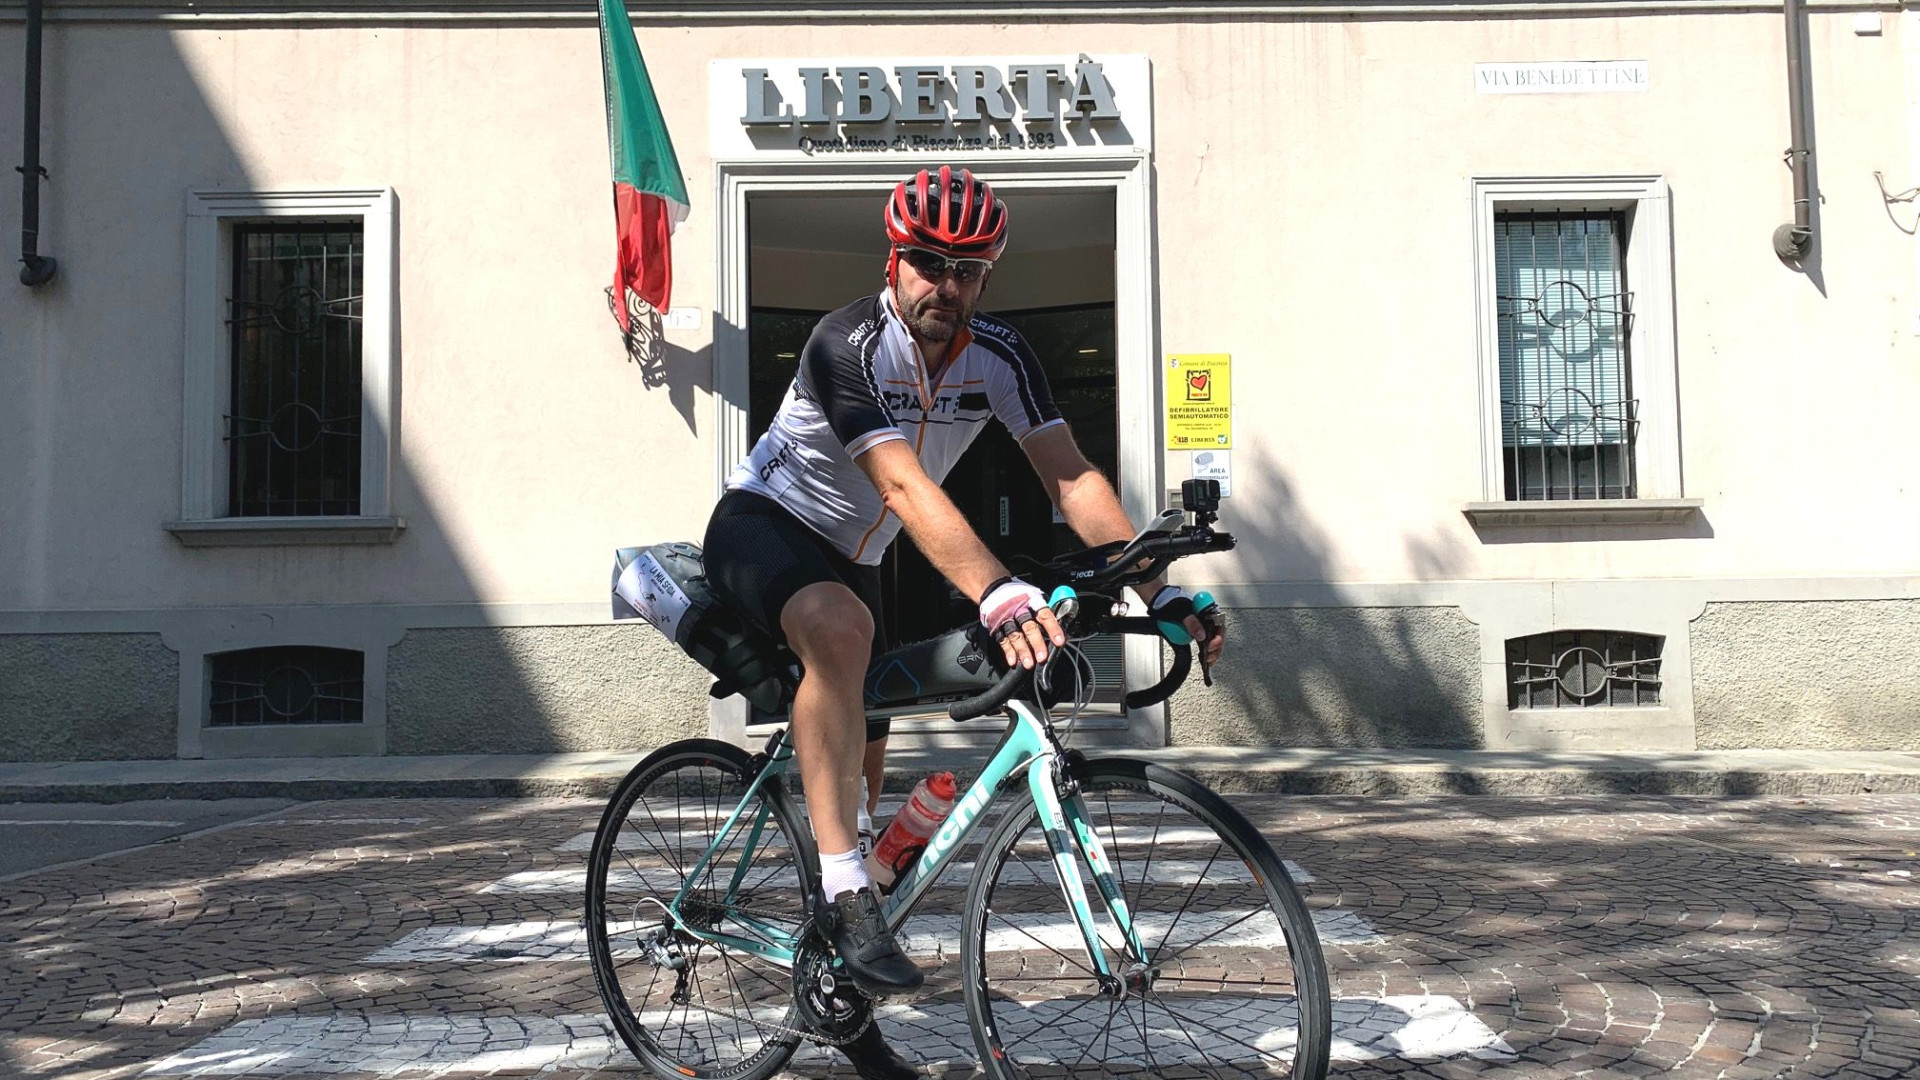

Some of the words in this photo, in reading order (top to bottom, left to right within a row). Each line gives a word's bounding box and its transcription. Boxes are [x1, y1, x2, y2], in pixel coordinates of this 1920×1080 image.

[1482, 69, 1509, 86] VIA
[1515, 68, 1645, 86] BENEDETTINE
[740, 53, 1121, 125] LIBERTÀ
[799, 135, 888, 157] Quotidiano
[892, 134, 908, 152] di
[912, 134, 984, 152] Piacenza
[987, 132, 1012, 151] dal
[1017, 131, 1056, 150] 1883
[970, 317, 1011, 337] CRAFT
[889, 393, 952, 414] CRAFT
[760, 442, 793, 483] CRAFT
[661, 580, 676, 598] SFIDA
[958, 653, 985, 664] BRN
[881, 778, 991, 919] ianchi
